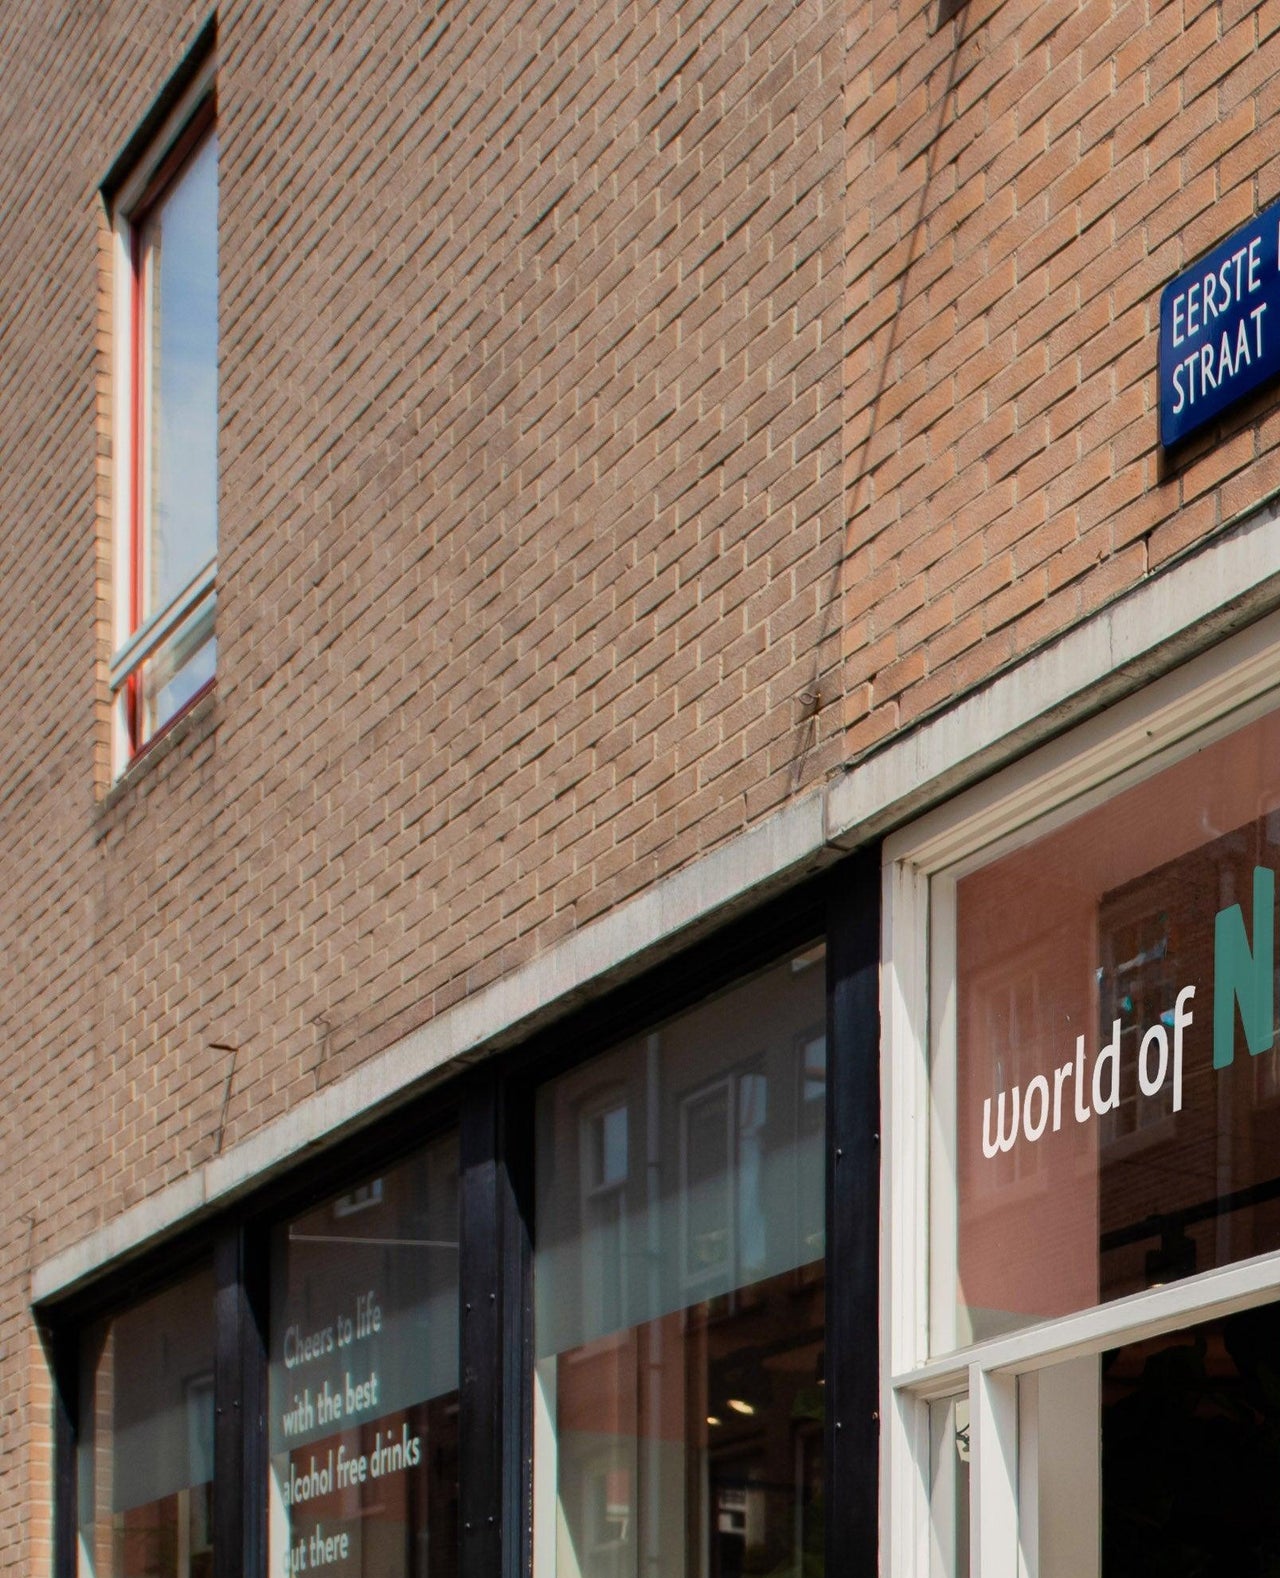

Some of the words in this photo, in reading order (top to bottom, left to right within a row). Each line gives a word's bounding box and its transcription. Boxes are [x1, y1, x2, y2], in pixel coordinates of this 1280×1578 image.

[1173, 237, 1261, 348] EERSTE
[1173, 303, 1267, 414] STRAAT
[981, 1018, 1122, 1158] world
[1138, 985, 1196, 1112] of
[283, 1324, 333, 1369] Cheers
[337, 1314, 352, 1347] to
[356, 1290, 381, 1339] life
[283, 1389, 314, 1437] with
[318, 1380, 342, 1425] the
[345, 1372, 377, 1415] best
[283, 1450, 333, 1505] alcohol
[336, 1444, 367, 1489] free
[370, 1423, 420, 1478] drinks
[310, 1523, 349, 1568] there
